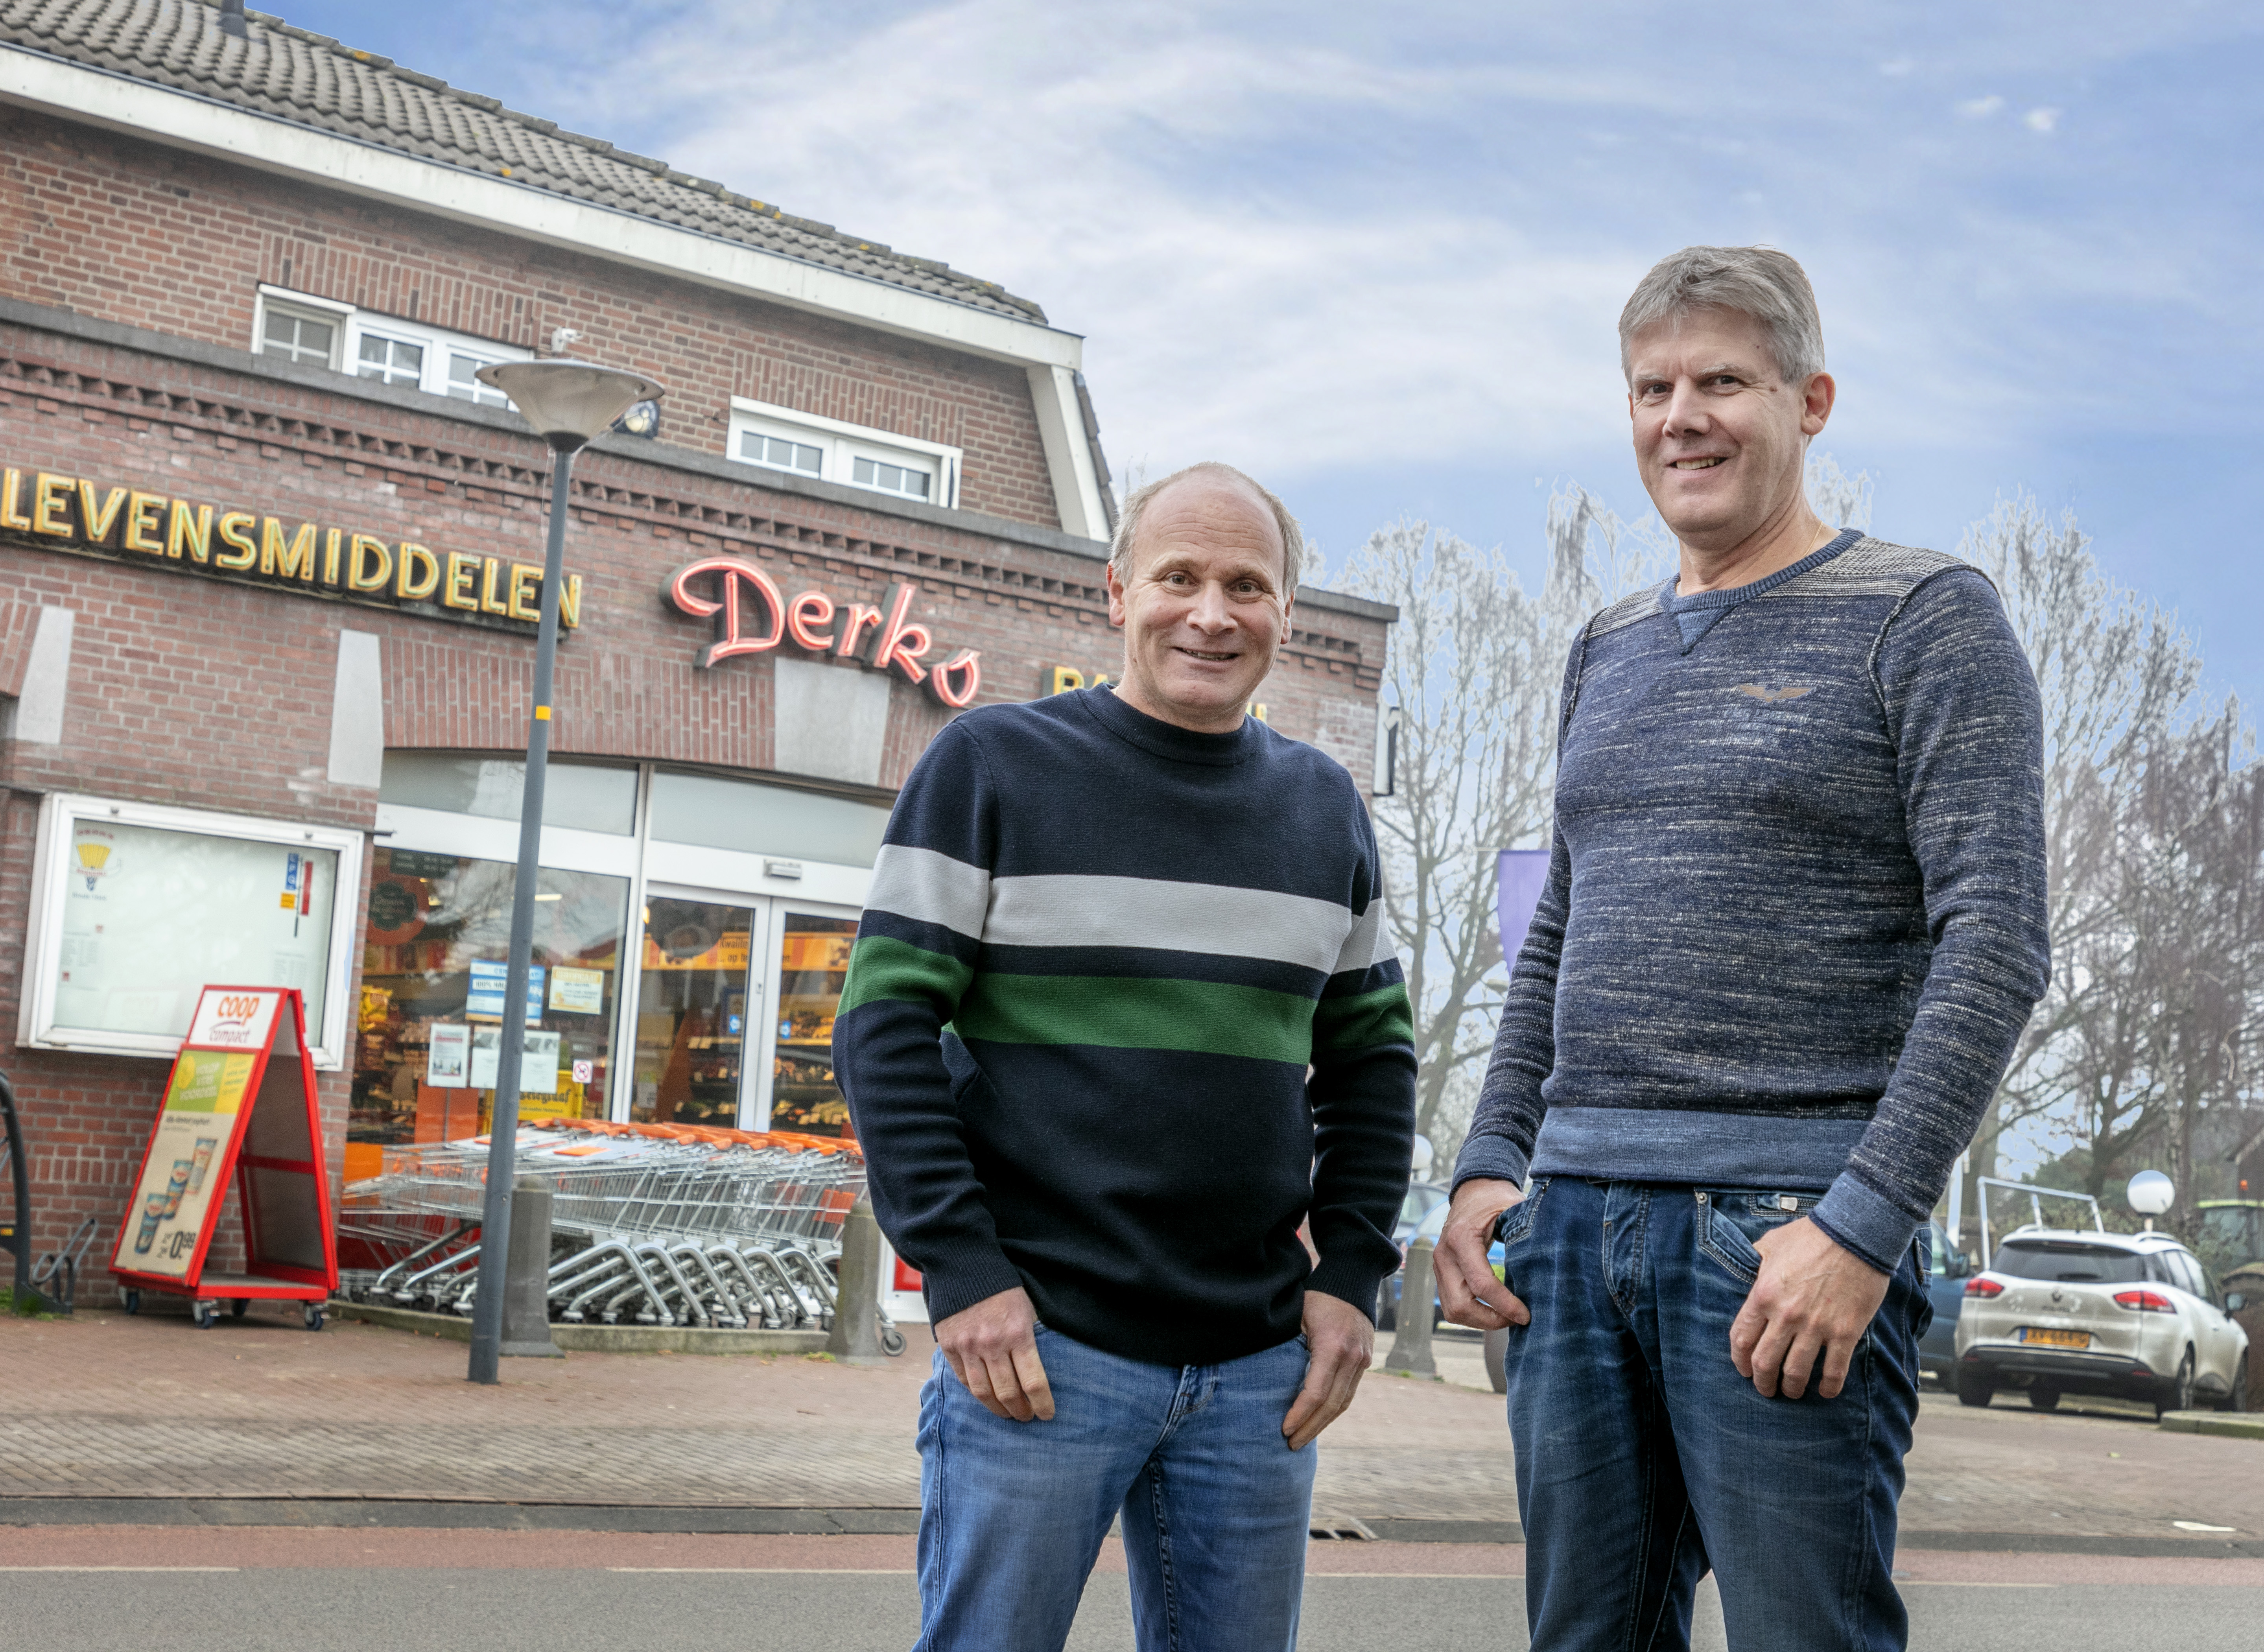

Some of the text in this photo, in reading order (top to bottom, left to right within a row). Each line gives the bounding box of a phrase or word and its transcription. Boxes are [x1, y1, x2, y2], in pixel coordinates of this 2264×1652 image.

[1, 468, 582, 628] LEVENSMIDDELEN
[670, 556, 981, 708] Derko
[209, 1028, 250, 1045] compact
[218, 996, 259, 1027] coop
